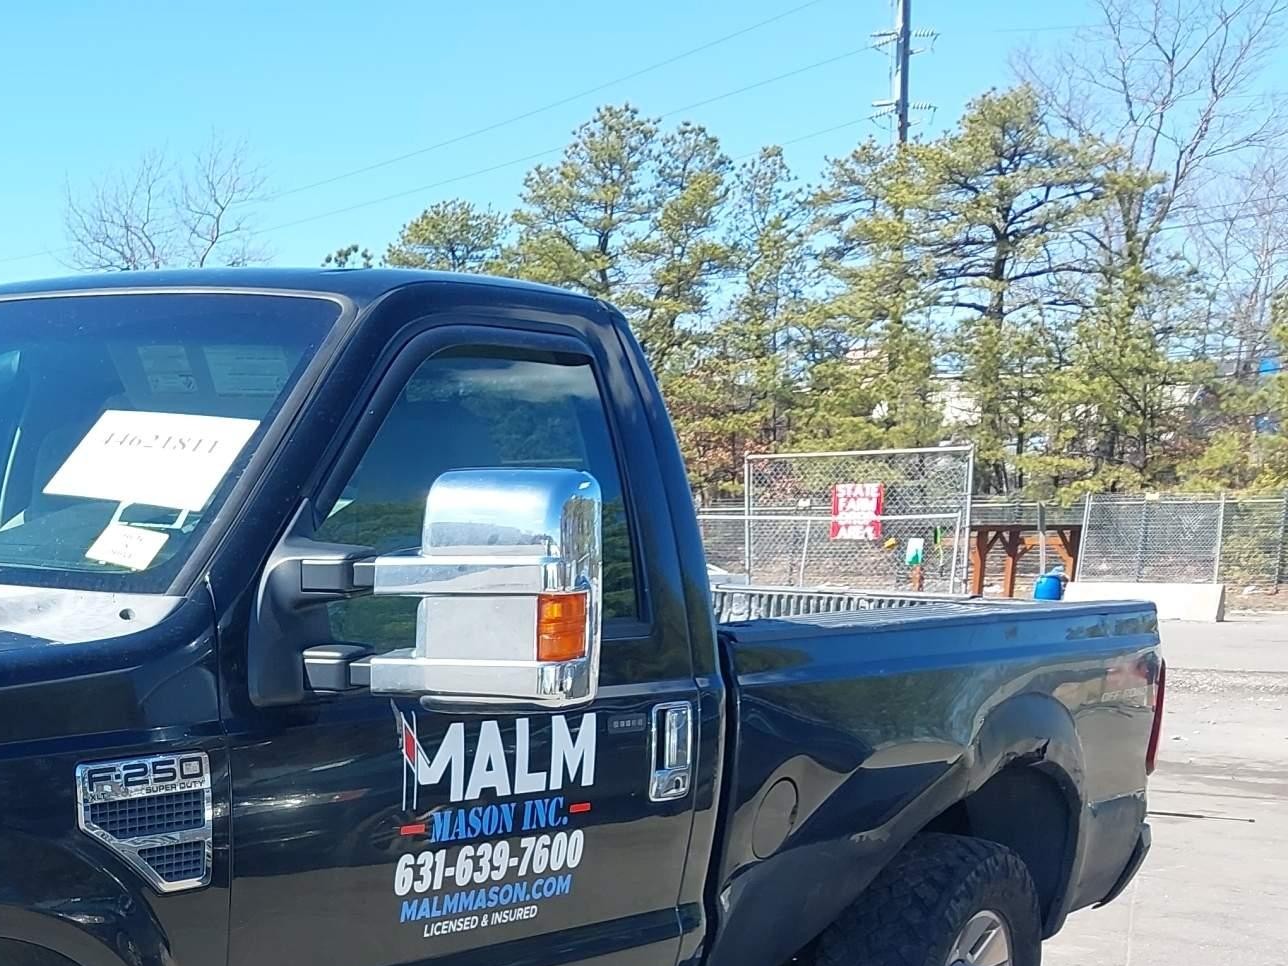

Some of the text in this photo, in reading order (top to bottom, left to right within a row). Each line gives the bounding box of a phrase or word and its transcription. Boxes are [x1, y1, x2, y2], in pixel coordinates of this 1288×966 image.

[836, 483, 879, 497] STATE
[88, 757, 203, 793] F-250
[400, 711, 597, 812] MALM
[89, 792, 107, 802] XLT
[145, 780, 205, 794] SUPER DUTY
[429, 797, 568, 844] MASON INC.
[394, 829, 584, 896] 631-639-7600
[400, 874, 573, 923] MALMMASON.COM
[423, 905, 538, 938] LICENSED & INSURED
